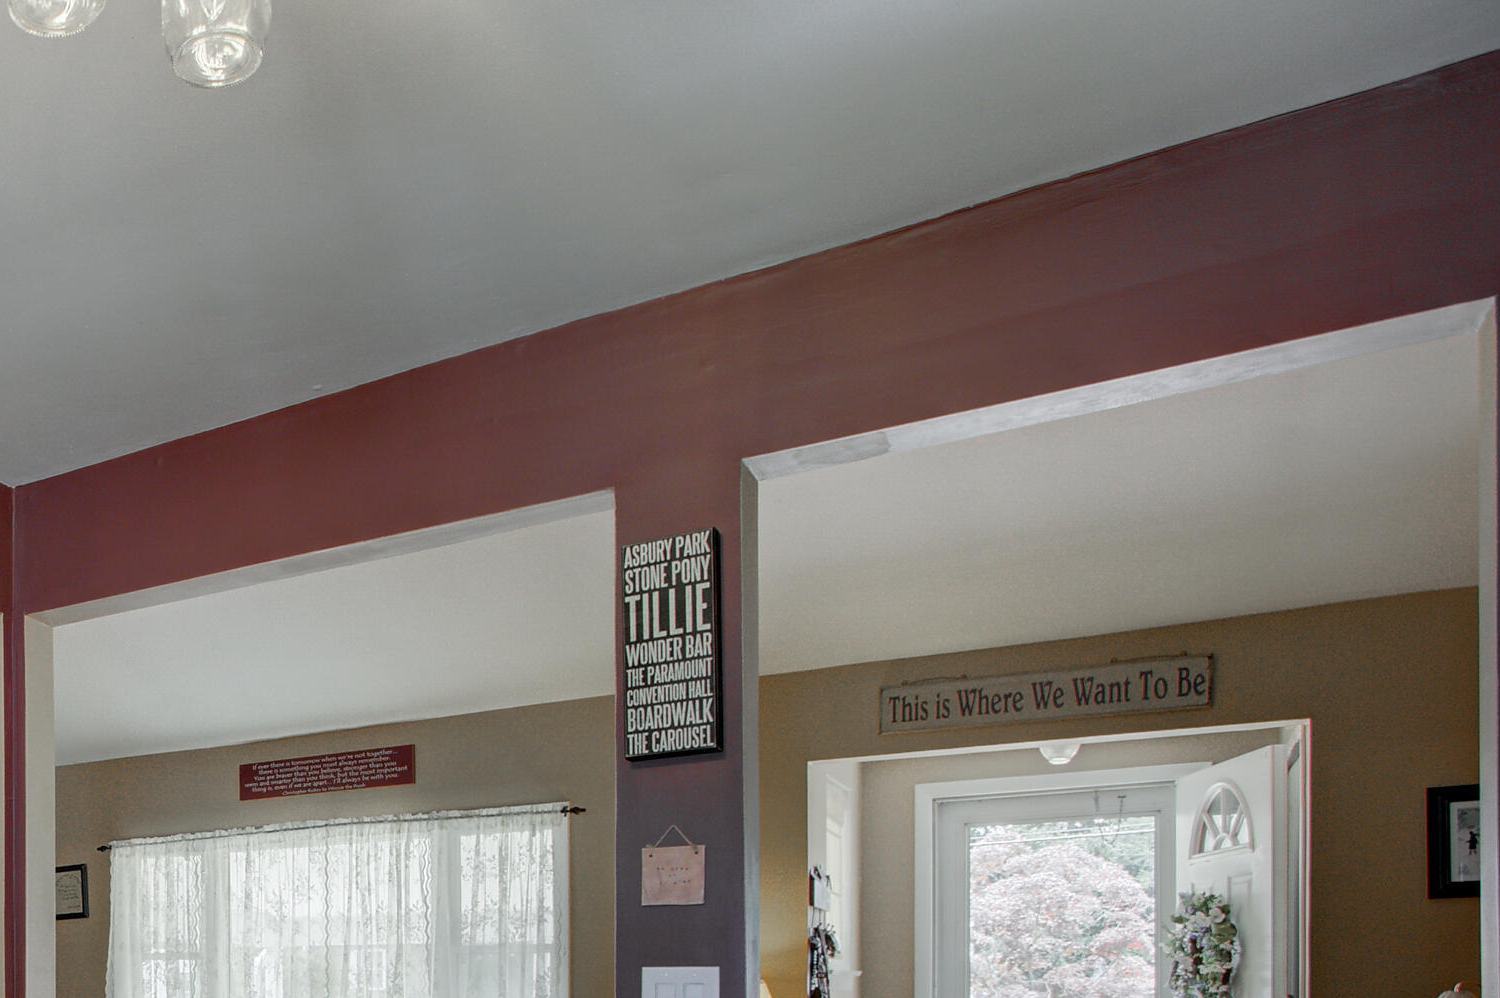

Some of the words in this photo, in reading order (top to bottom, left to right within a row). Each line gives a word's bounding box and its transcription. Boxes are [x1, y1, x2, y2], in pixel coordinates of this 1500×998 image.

[624, 538, 673, 569] ASBURY
[675, 530, 710, 559] PARK
[625, 562, 669, 594] STONE
[671, 554, 711, 586] PONY
[624, 582, 712, 642] TILLIE
[625, 637, 683, 668] WONDER
[685, 632, 712, 658] BAR
[626, 667, 645, 688] THE
[647, 657, 713, 685] PARAMOUNT
[627, 682, 687, 707] CONVENTION
[689, 678, 714, 699] HALL
[888, 695, 928, 723] This
[936, 693, 950, 720] is
[956, 688, 1024, 717] Where
[1031, 681, 1064, 709] We
[1072, 676, 1131, 707] Want
[1139, 670, 1168, 700] To
[1177, 667, 1205, 698] Be
[627, 697, 714, 733] BOARDWALK
[627, 732, 649, 755] THE
[651, 724, 715, 753] CAROUSEL
